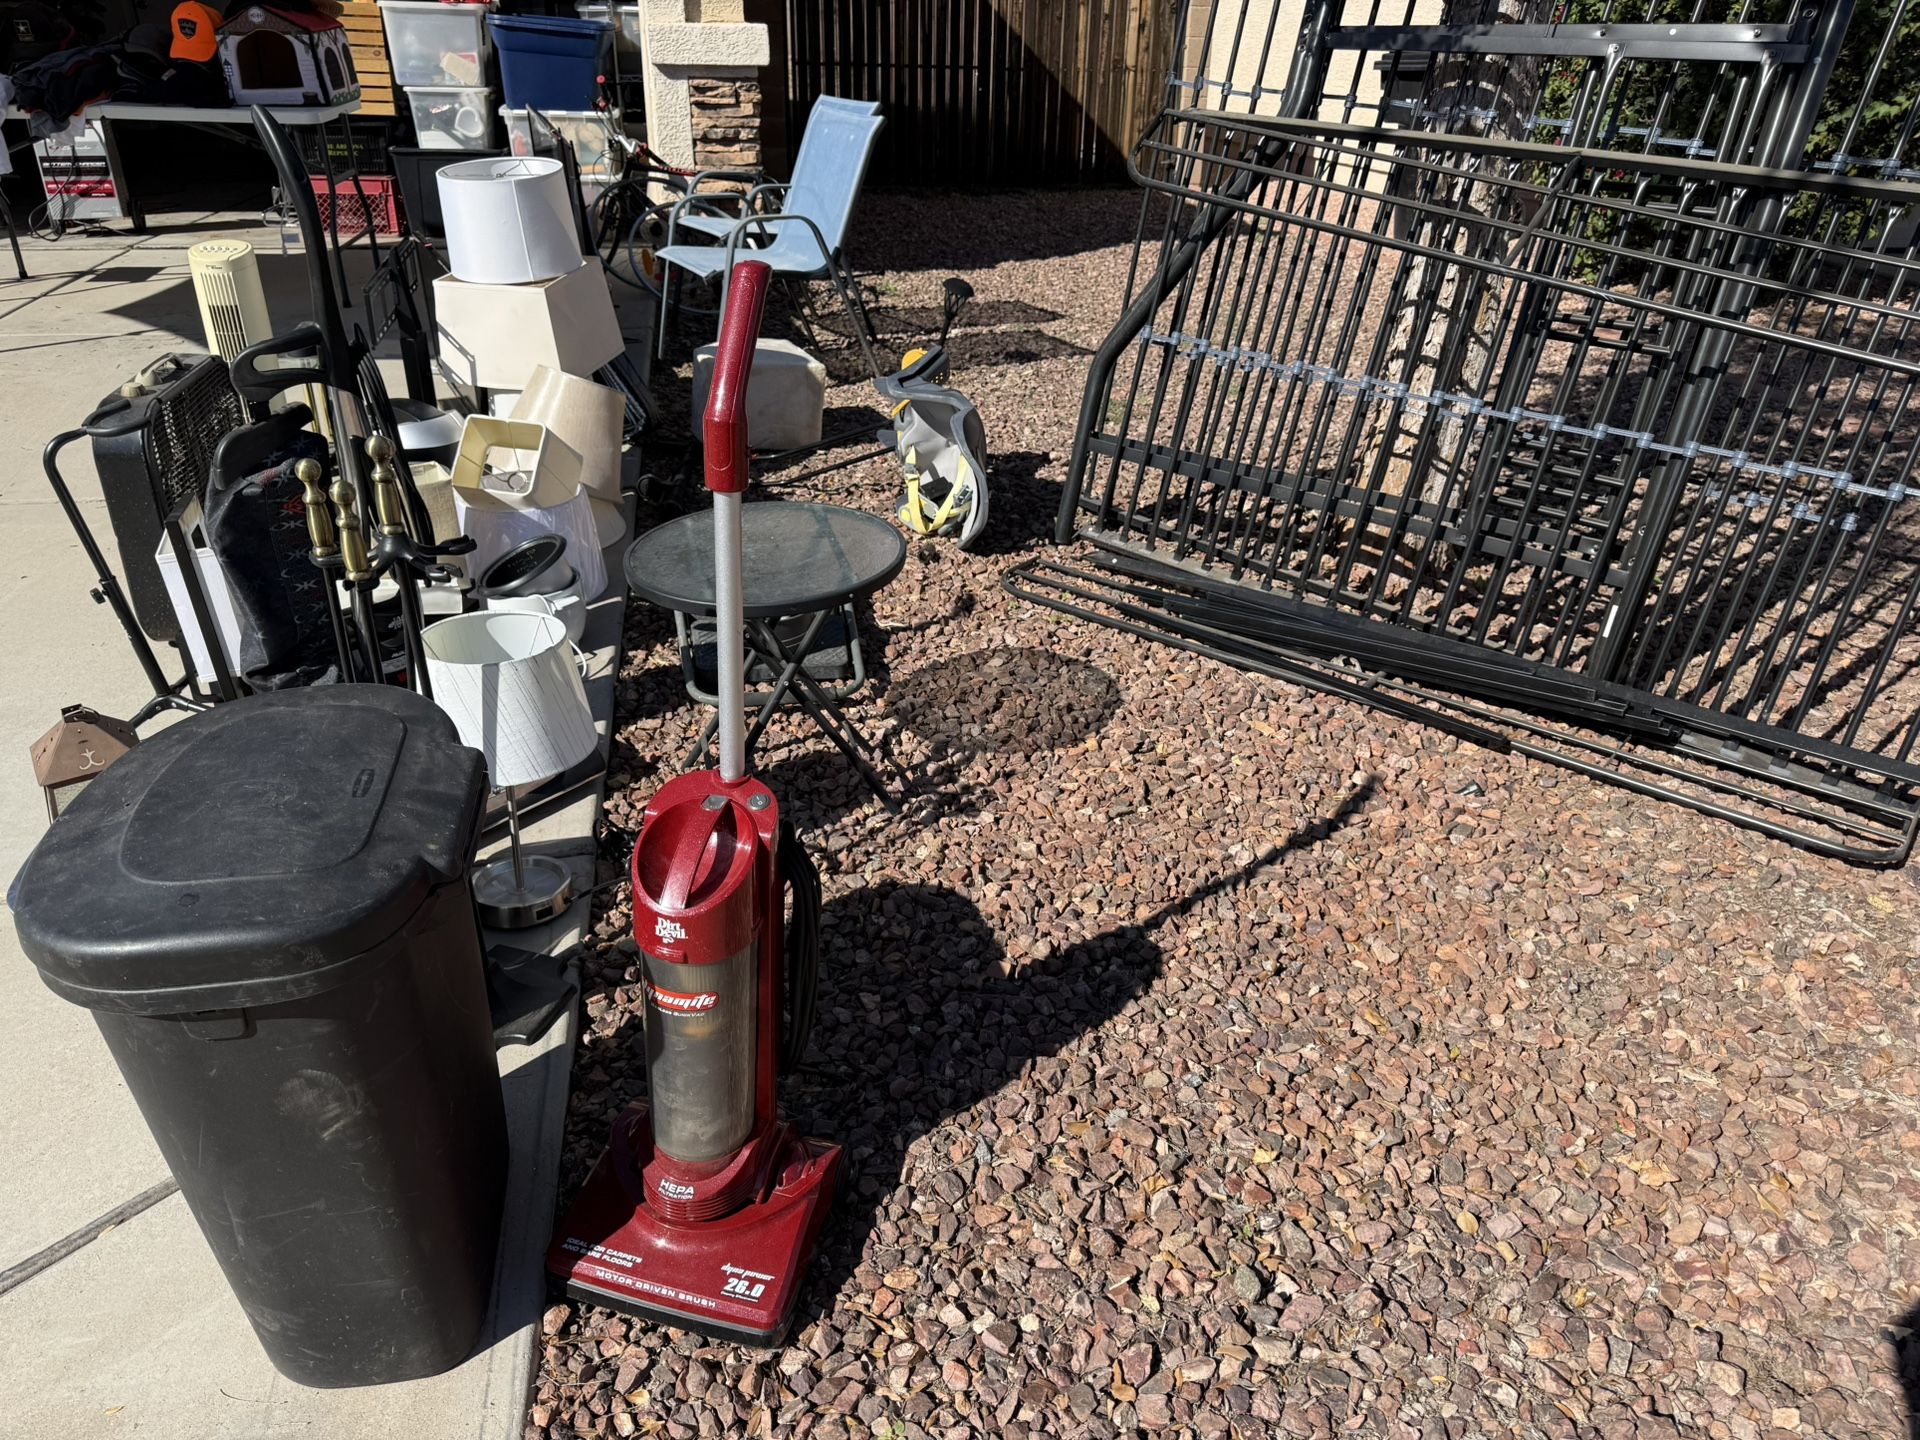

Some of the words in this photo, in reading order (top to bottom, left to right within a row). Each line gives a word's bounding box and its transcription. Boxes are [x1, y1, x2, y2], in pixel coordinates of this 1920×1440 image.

[655, 925, 688, 939] Devil
[657, 917, 681, 931] Dirt
[658, 1187, 693, 1200] FILTRATION
[660, 1179, 694, 1194] HEPA
[561, 1243, 580, 1252] AND
[579, 1248, 601, 1259] BARE
[601, 1254, 634, 1268] FLOORS
[566, 1237, 588, 1247] IDEAL
[588, 1244, 606, 1253] FOR
[606, 1249, 643, 1264] CARPETS
[595, 1269, 633, 1286] MOTOR
[635, 1282, 676, 1297] DRIVEN
[678, 1292, 717, 1308] BRUSH
[723, 1277, 766, 1298] 26.0
